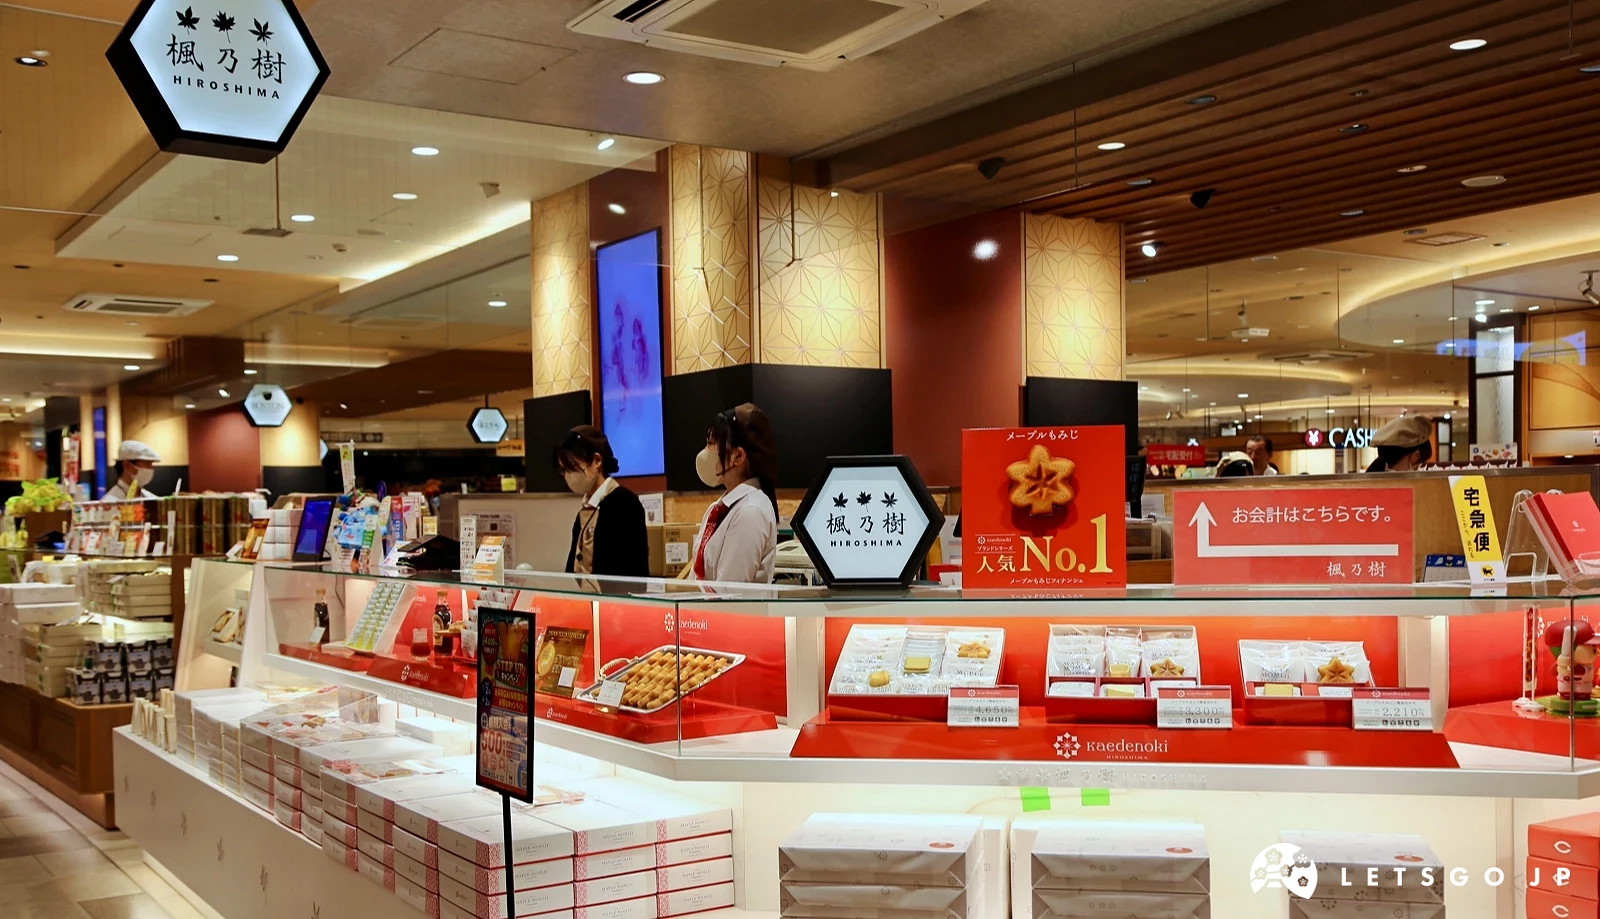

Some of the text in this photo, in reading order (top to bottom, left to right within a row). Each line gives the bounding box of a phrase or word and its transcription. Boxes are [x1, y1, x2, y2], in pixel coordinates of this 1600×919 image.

[166, 33, 287, 84] 楓乃樹
[173, 75, 280, 99] HIROSHIMA
[1006, 430, 1079, 441] メープルもみじ
[1328, 427, 1377, 448] CASH
[826, 512, 907, 536] 楓乃樹
[1232, 505, 1391, 524] お会計はこちらです。
[1463, 487, 1490, 552] 宅急便
[830, 539, 902, 547] HIROSHIMA
[1020, 513, 1113, 573] No.1
[976, 554, 1016, 574] 人気
[1327, 561, 1386, 578] 楓乃樹
[496, 659, 524, 673] STEP UP
[482, 729, 503, 755] 500
[1122, 772, 1208, 783] HIROSHIMA
